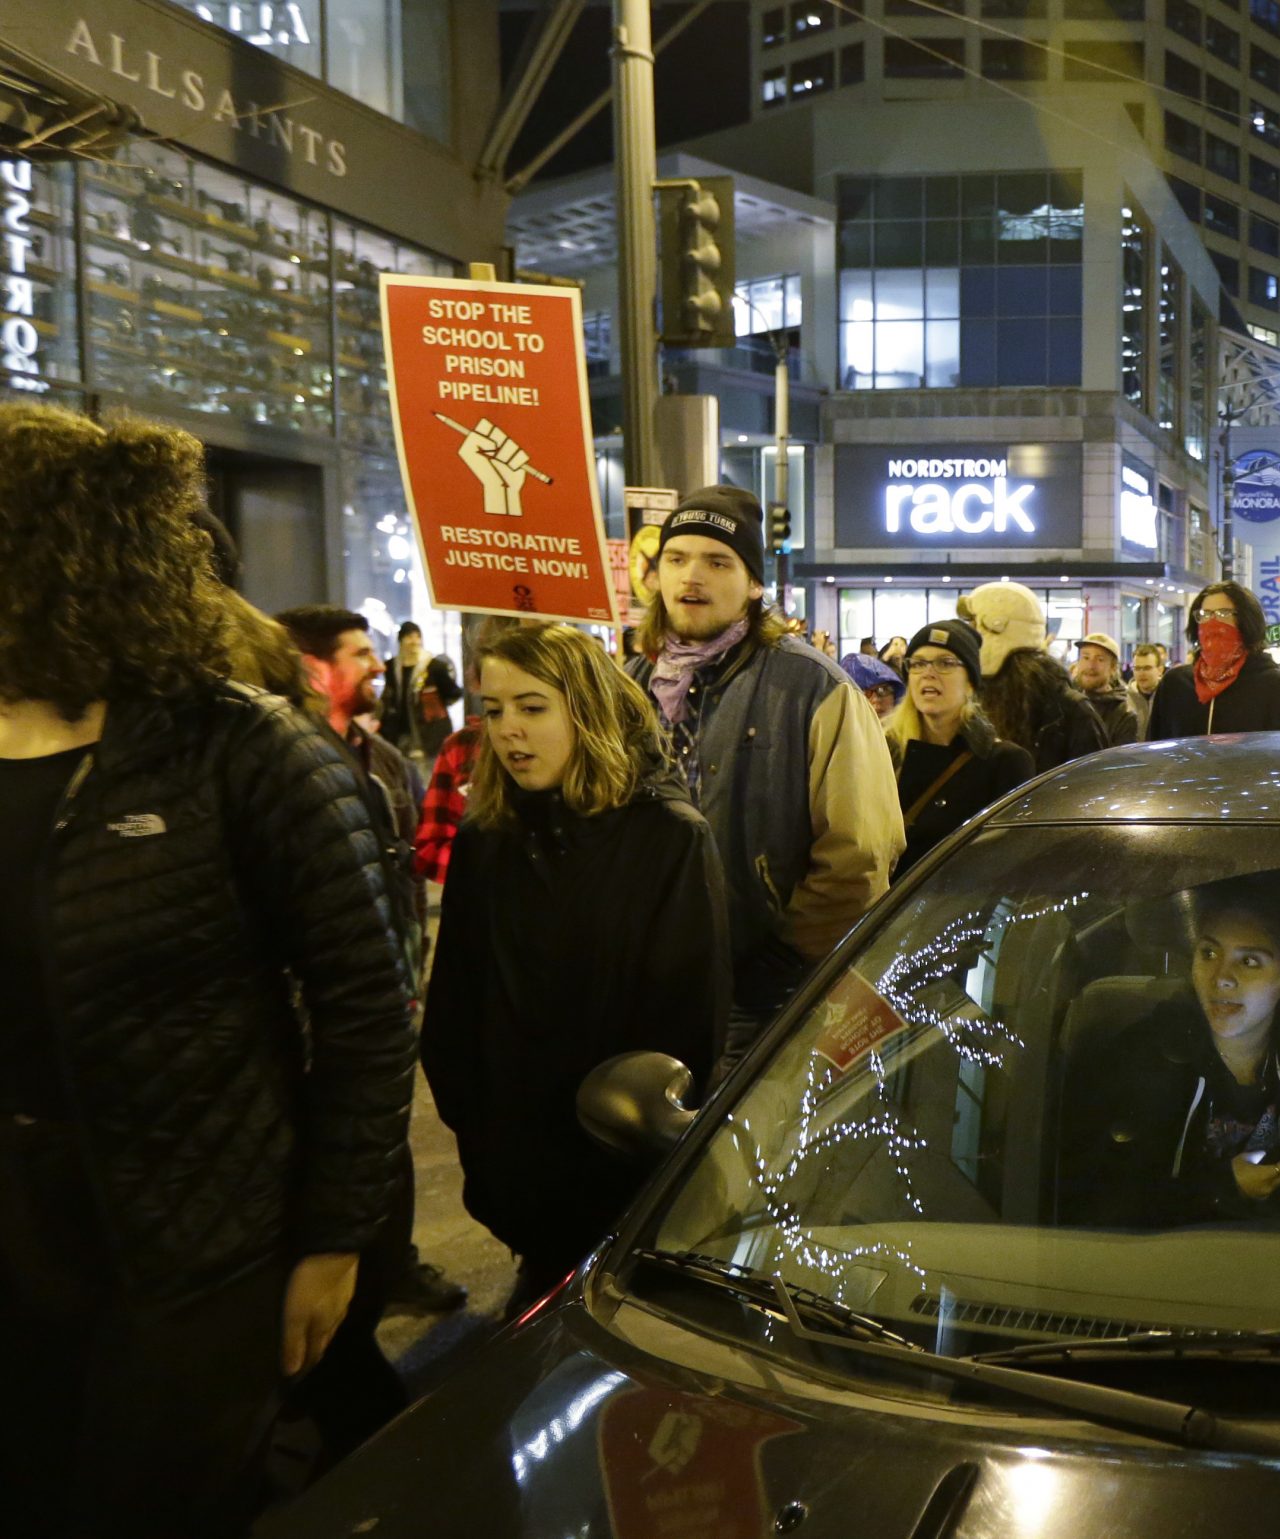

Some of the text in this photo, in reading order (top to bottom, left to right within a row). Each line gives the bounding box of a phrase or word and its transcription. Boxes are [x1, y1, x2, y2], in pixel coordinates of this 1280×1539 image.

[65, 18, 347, 177] ALLSAINTS
[428, 299, 532, 325] STOP THE
[422, 326, 544, 353] SCHOOL TO
[445, 355, 525, 378] PRISON
[438, 381, 540, 406] PIPELINE!
[889, 459, 1007, 478] NORDSTROM
[885, 476, 1036, 534] rack
[440, 525, 582, 555] RESTORATIVE
[444, 550, 529, 573] JUSTICE
[533, 558, 590, 580] NOW!
[1259, 555, 1280, 626] ORAIL
